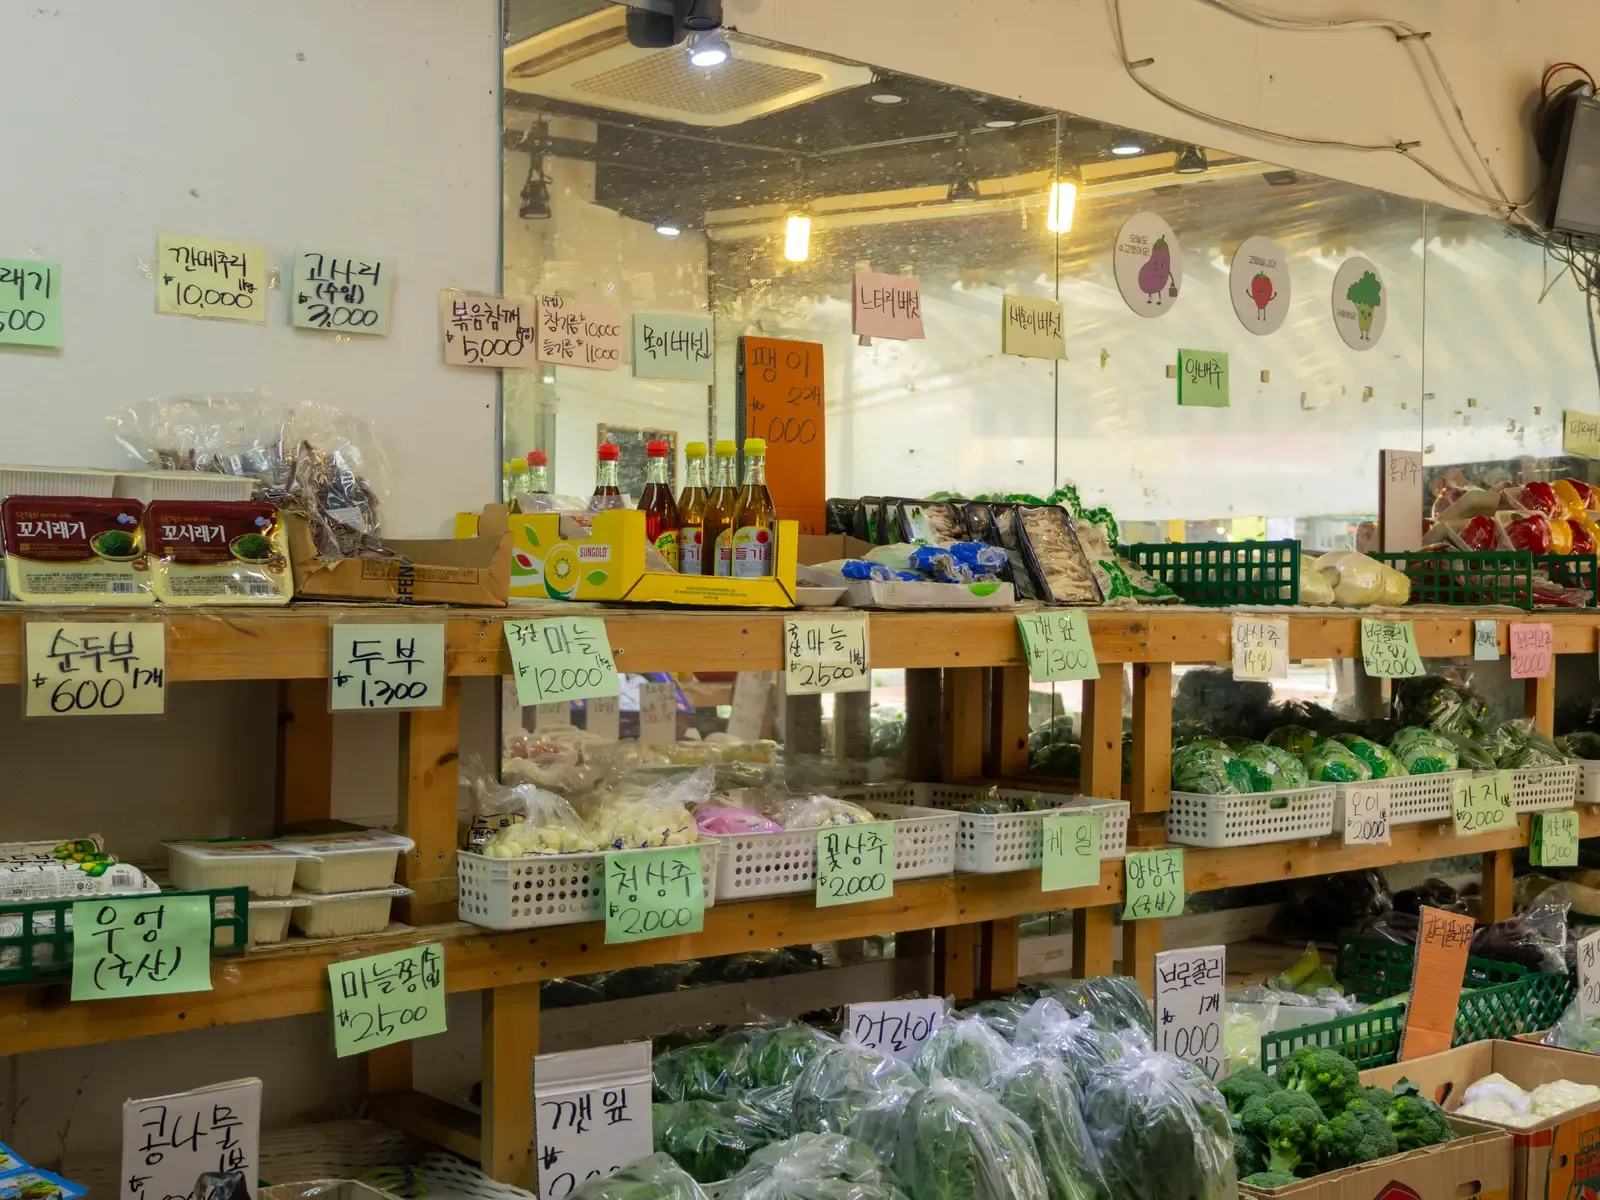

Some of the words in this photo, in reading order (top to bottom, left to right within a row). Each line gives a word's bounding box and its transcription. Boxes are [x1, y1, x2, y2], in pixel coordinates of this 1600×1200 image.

[305, 252, 381, 286] 고사리
[451, 299, 520, 332] 볶음참깨
[861, 285, 920, 319] 느타리버섯
[1009, 305, 1062, 339] 새송이버섯
[543, 338, 576, 359] 들기름
[752, 346, 809, 382] 팽이
[787, 385, 821, 407] 2개
[1388, 451, 1421, 486] 홍고추
[17, 521, 86, 539] 꼬시래기
[162, 525, 226, 542] 꼬시래기
[579, 547, 607, 558] SUNGOLD
[543, 624, 598, 654] 마늘
[807, 624, 847, 656] 마늘
[1025, 614, 1076, 643] 깻잎
[47, 628, 139, 673] 순두부
[348, 637, 425, 675] 두부
[133, 668, 163, 689] 1개
[1352, 791, 1379, 816] 오이
[1456, 780, 1498, 808] 가지
[824, 831, 888, 872] 꽃상추
[1045, 822, 1092, 856] 케일
[610, 860, 697, 902] 청상추
[1128, 852, 1181, 889] 양상추
[91, 905, 164, 953] 우엉
[94, 946, 182, 990] (국산)
[1198, 992, 1220, 1015] 1개
[541, 1087, 633, 1134] 깻잎
[138, 1104, 243, 1165] 콩나물
